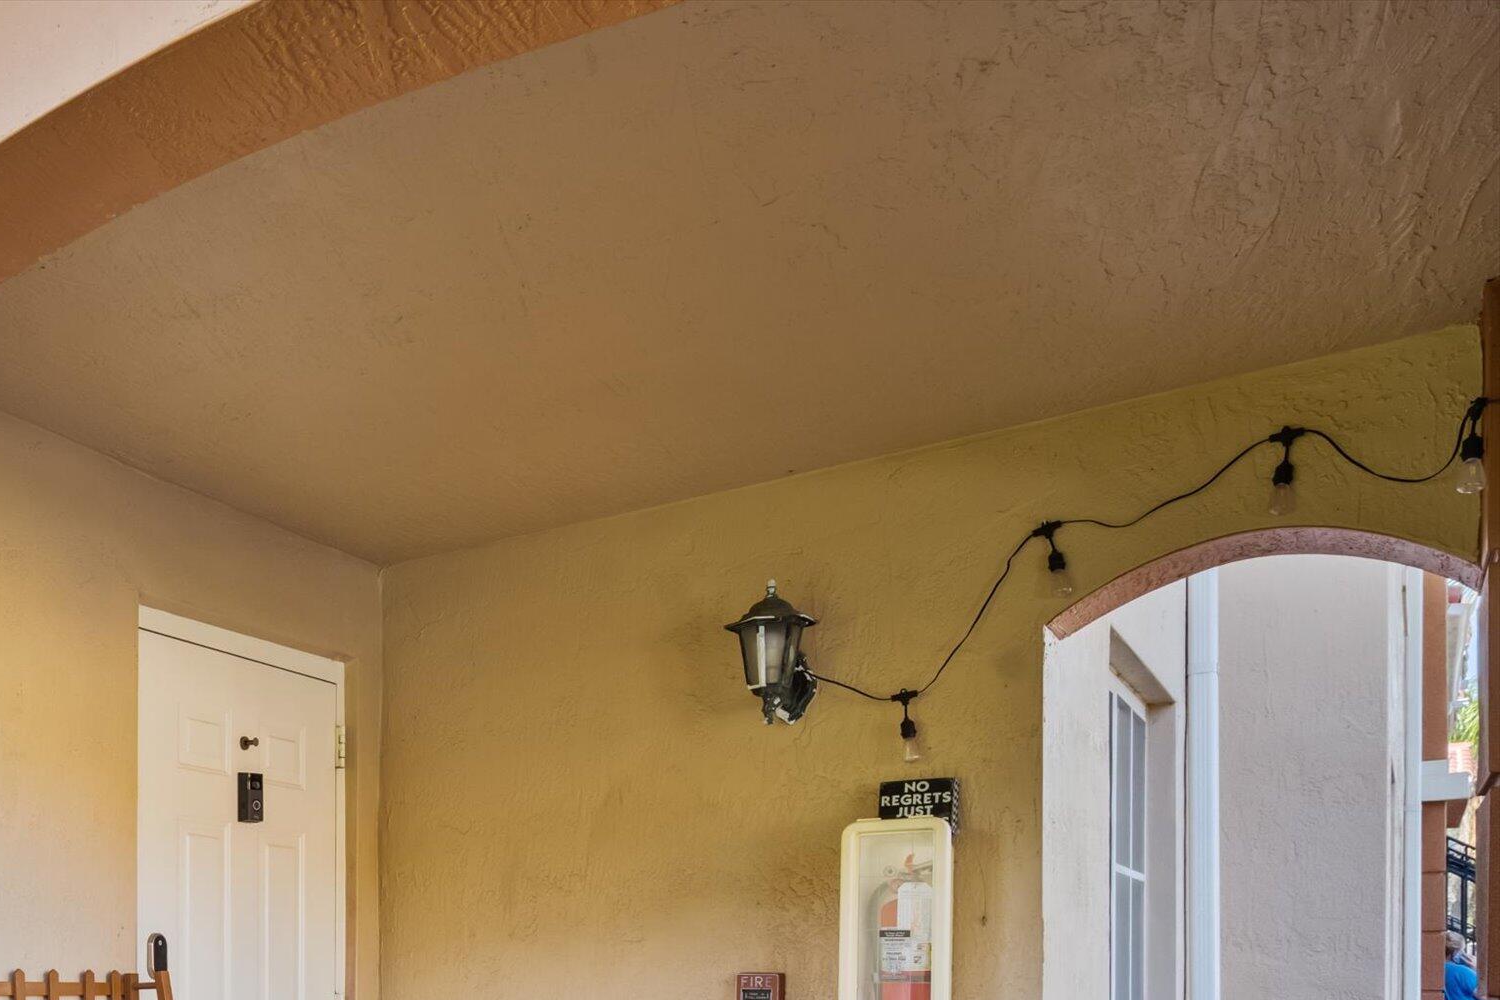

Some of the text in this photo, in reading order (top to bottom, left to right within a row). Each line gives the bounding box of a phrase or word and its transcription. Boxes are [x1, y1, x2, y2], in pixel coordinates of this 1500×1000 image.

[904, 781, 930, 793] NO
[881, 791, 951, 807] REGRETS
[896, 805, 933, 818] JUST
[740, 976, 772, 988] FIRE
